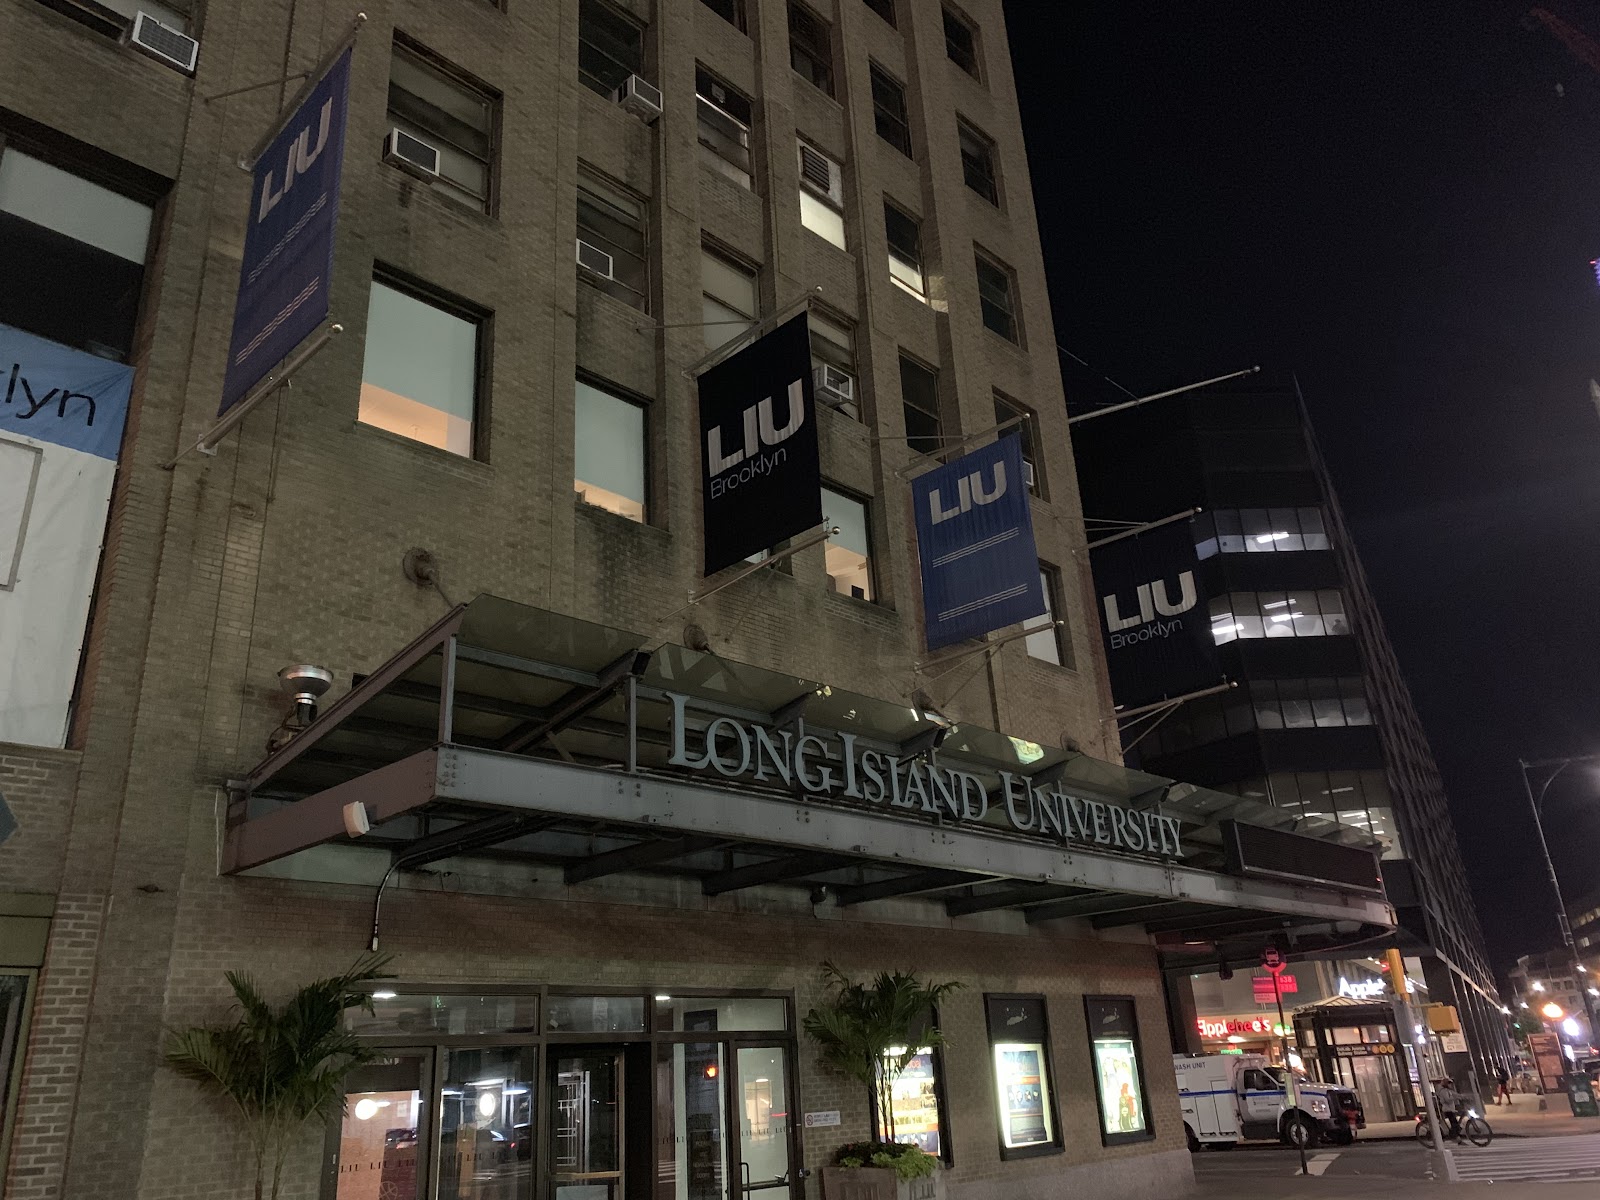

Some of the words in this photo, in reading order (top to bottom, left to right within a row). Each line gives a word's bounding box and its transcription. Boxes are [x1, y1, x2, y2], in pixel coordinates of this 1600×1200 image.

[258, 97, 332, 223] LIU
[0, 363, 96, 426] lyn
[707, 378, 805, 478] LIU
[710, 447, 787, 500] Brooklyn
[928, 460, 1007, 526] LIU
[1103, 570, 1197, 633] LIU
[1110, 618, 1183, 650] Brooklyn
[665, 691, 833, 794] LONG
[837, 731, 988, 822] ISLAND
[998, 770, 1185, 857] UNIVERSITY
[1197, 1017, 1271, 1038] Applebee's
